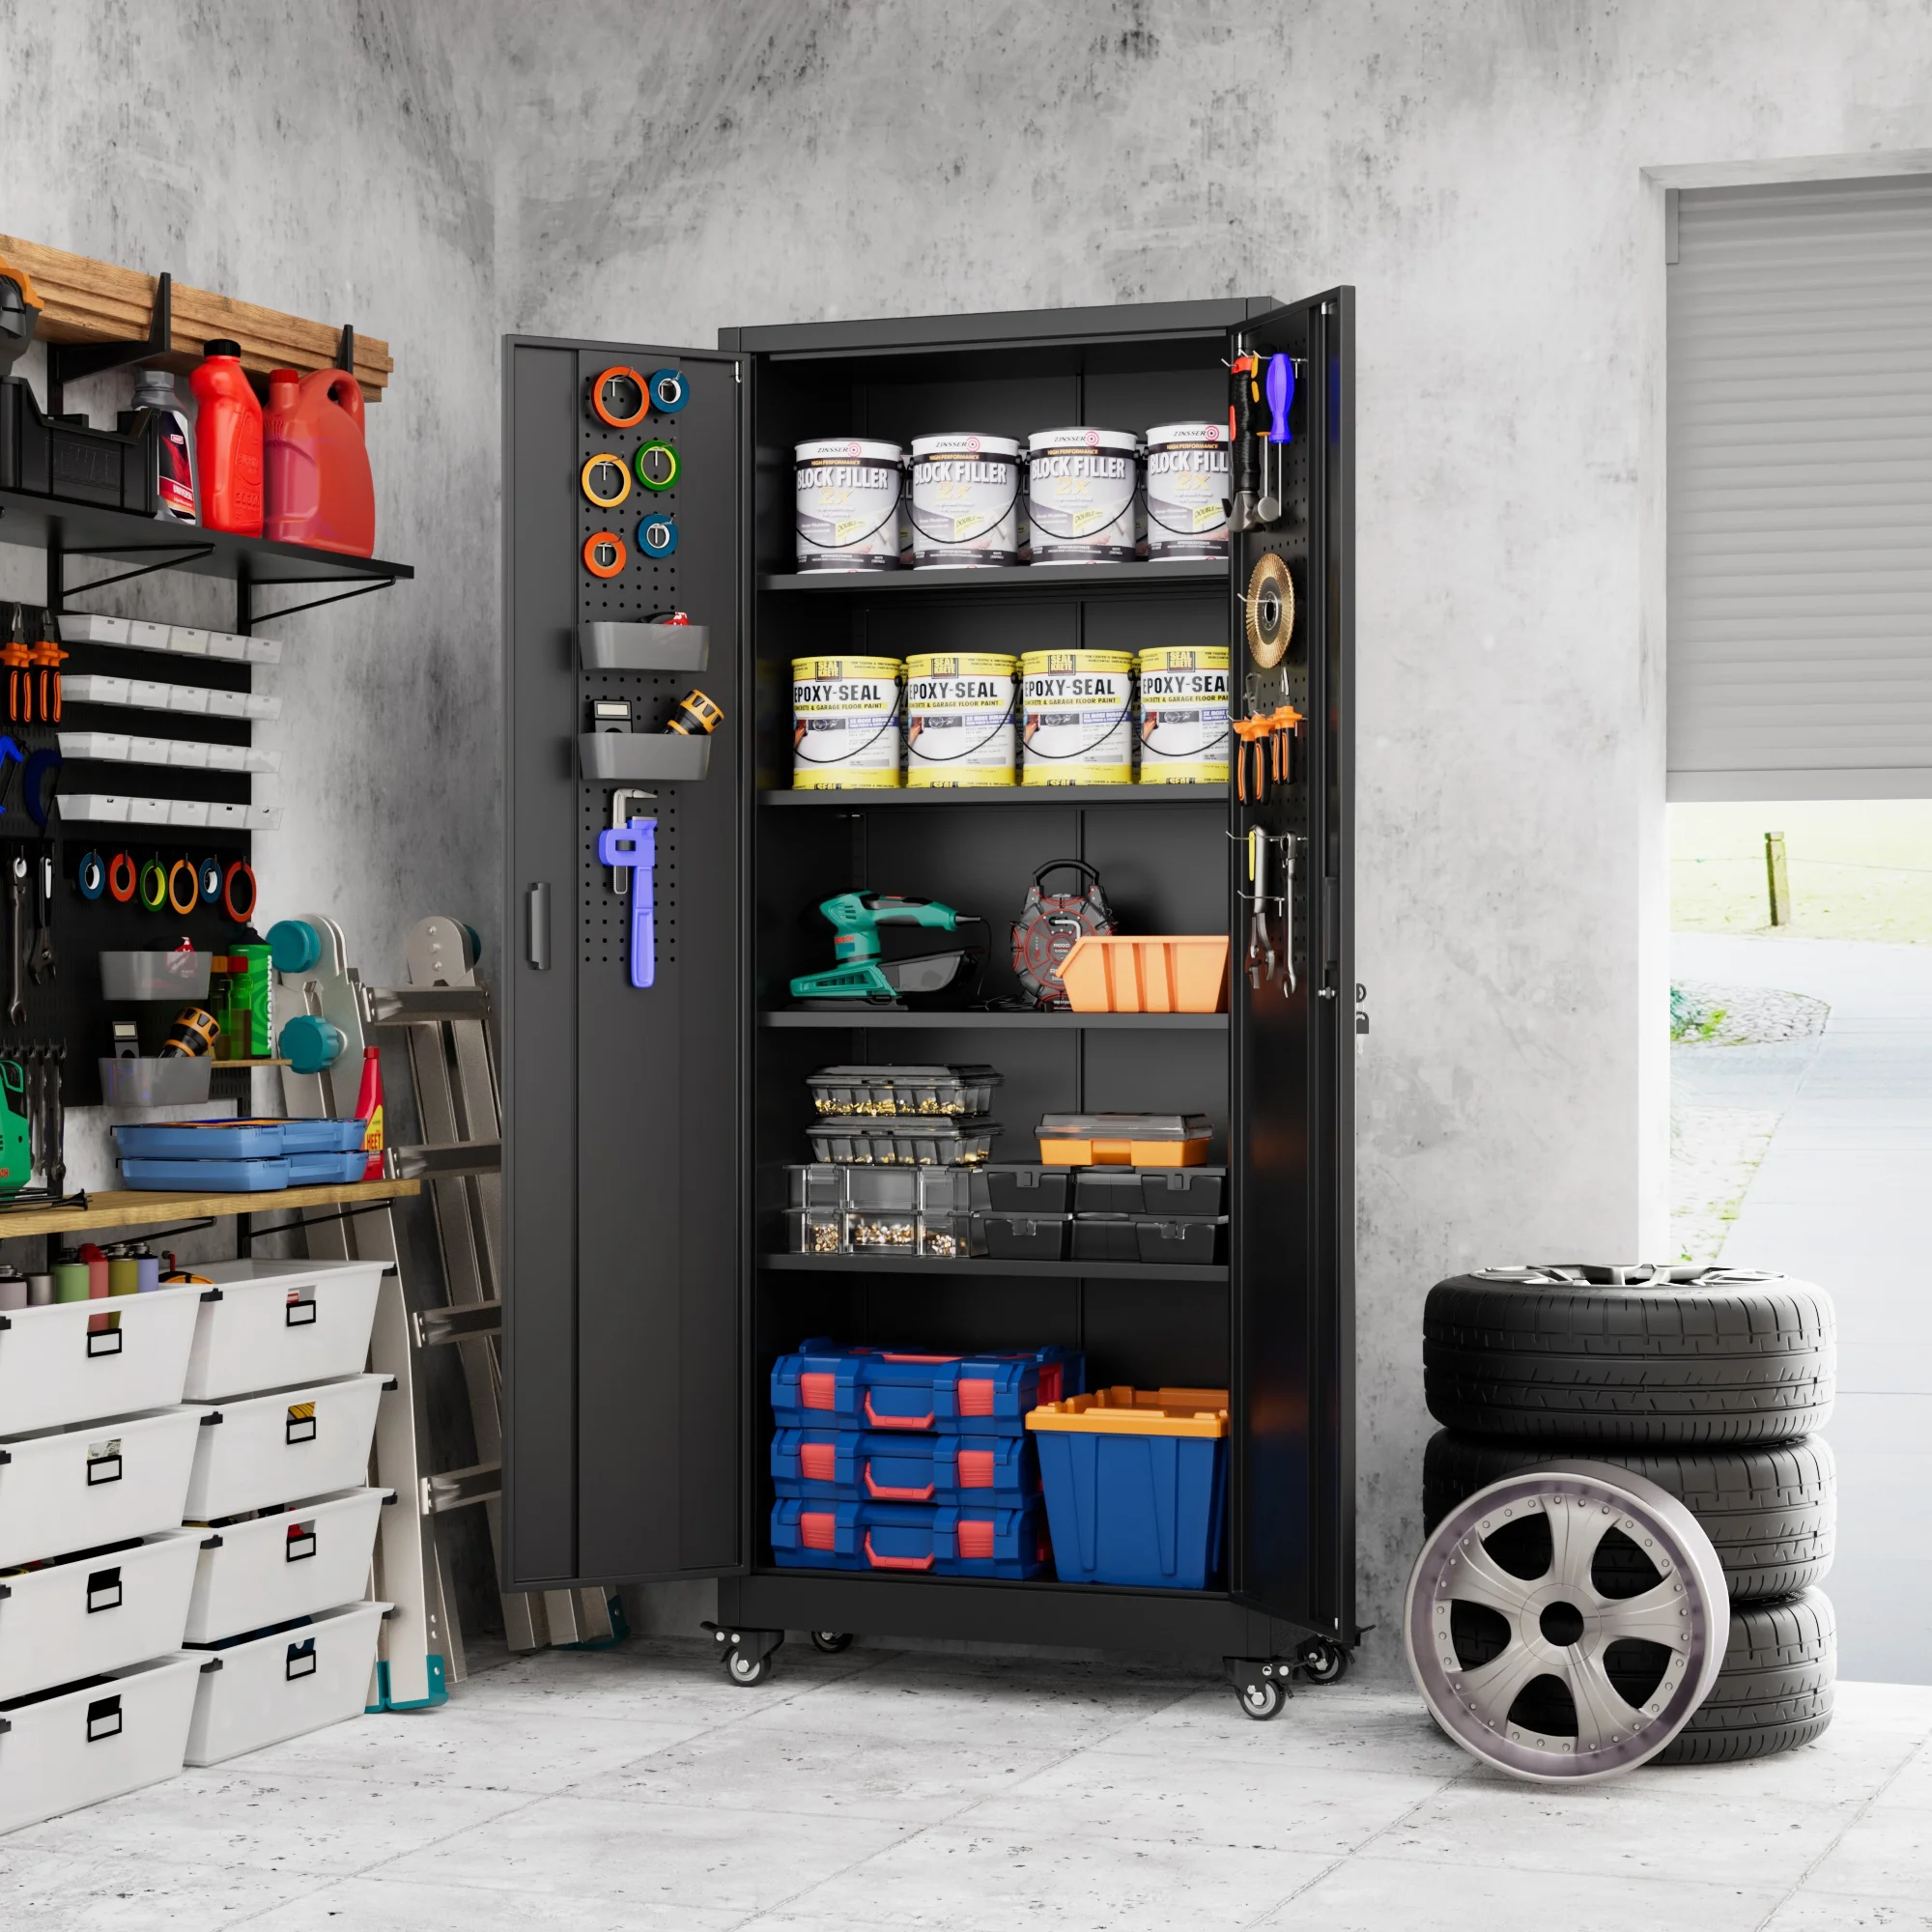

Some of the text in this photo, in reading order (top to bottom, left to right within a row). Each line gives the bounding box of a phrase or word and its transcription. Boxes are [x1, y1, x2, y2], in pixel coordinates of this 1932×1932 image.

[1032, 456, 1125, 480] BLOCK FILLER
[1151, 451, 1229, 475] BLOCK FILL
[798, 468, 888, 490] BLOCK FILLER
[914, 462, 1007, 485] BLOCK FILLER
[794, 685, 881, 702] EPOXY-SEAL
[909, 682, 998, 700] EPOXY-SEAL
[1025, 679, 1115, 696] EPOXY-SEAL
[367, 1133, 382, 1150] HEET
